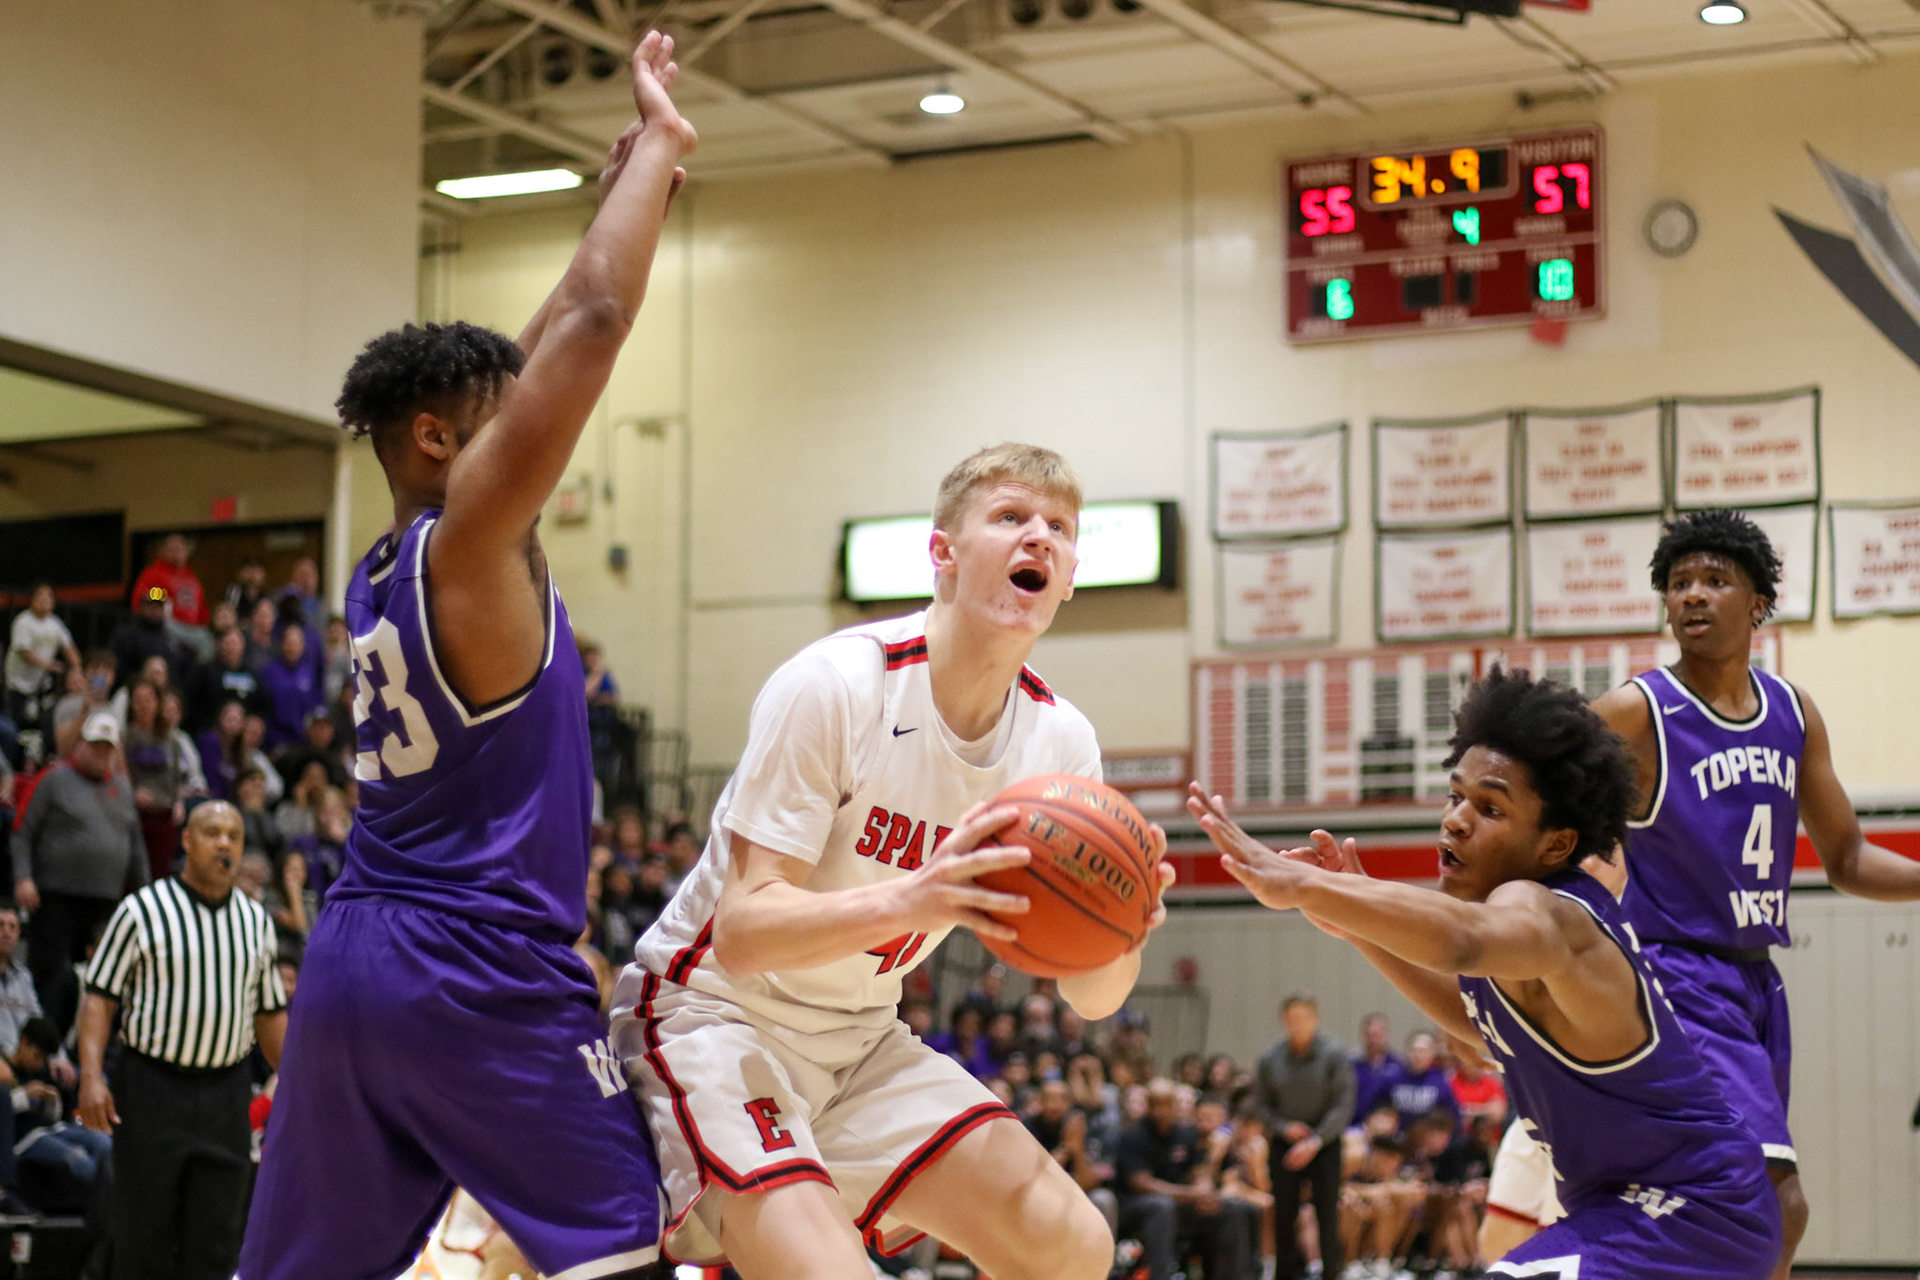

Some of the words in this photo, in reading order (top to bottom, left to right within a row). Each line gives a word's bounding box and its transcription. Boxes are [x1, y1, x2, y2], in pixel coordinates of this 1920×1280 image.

[1371, 148, 1480, 204] 34.9
[1533, 163, 1590, 214] 57
[1300, 186, 1356, 236] 55
[1452, 206, 1480, 245] 4
[1326, 278, 1354, 320] 6
[1538, 258, 1574, 300] 10
[1690, 745, 1797, 801] TOPEKA
[1741, 804, 1774, 880] 4
[743, 1097, 796, 1153] E
